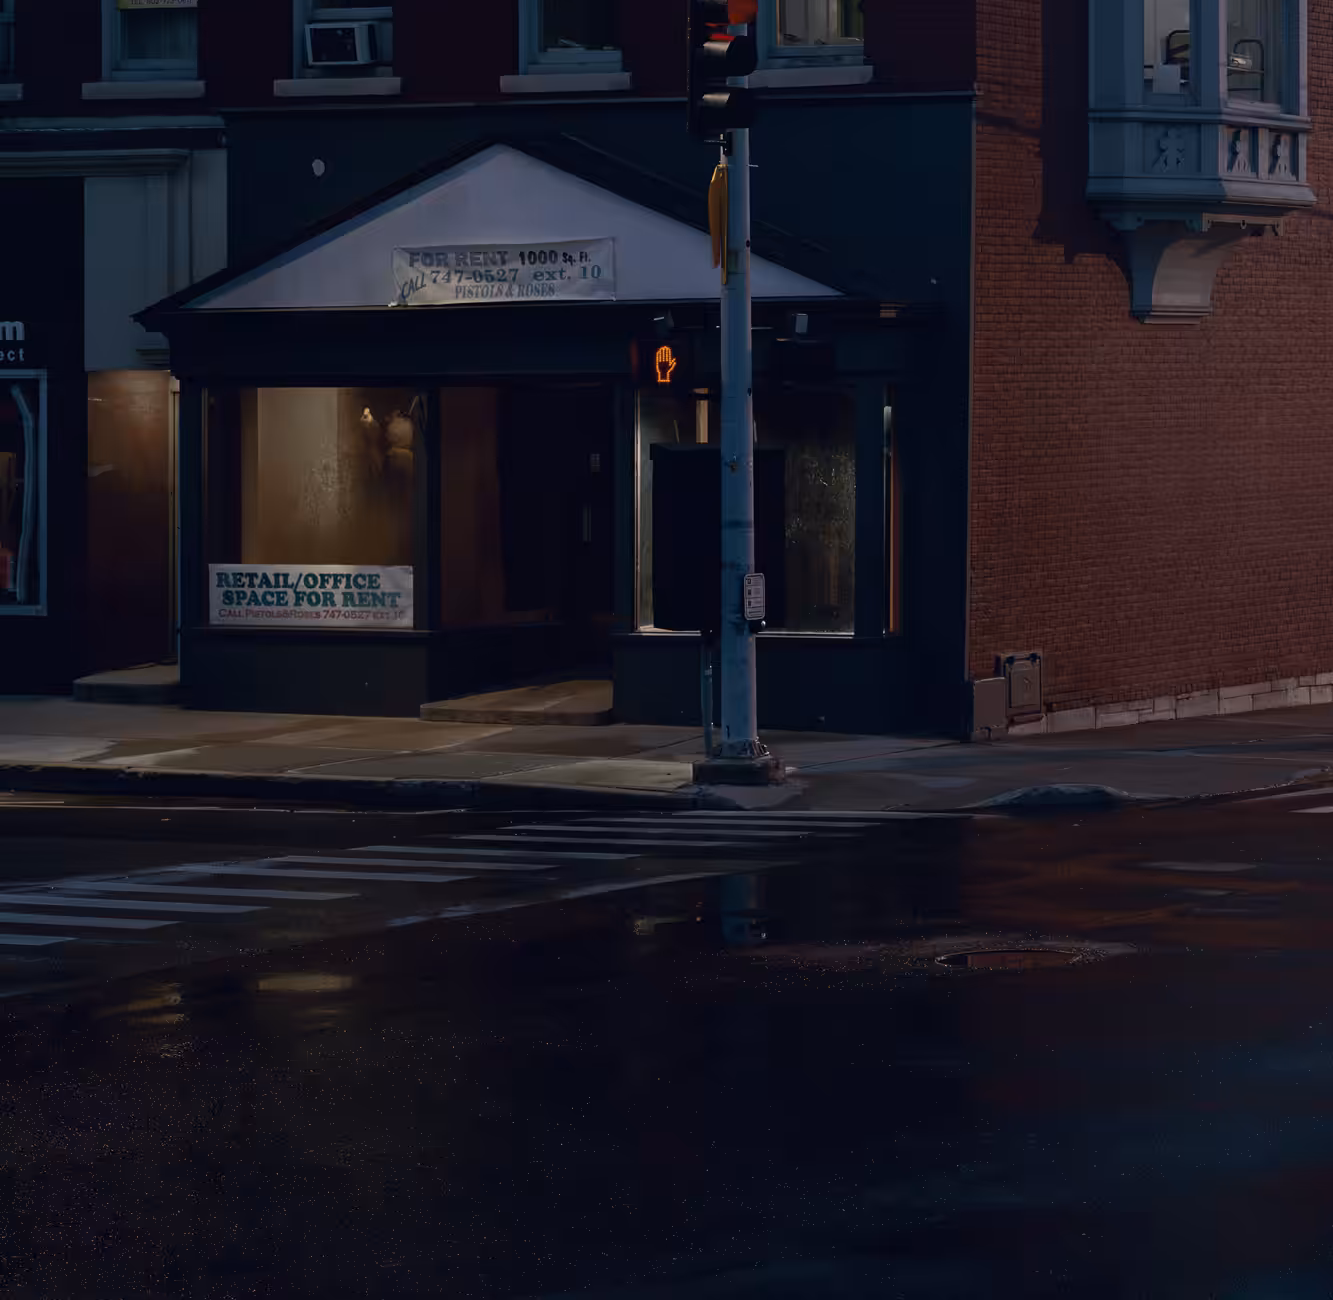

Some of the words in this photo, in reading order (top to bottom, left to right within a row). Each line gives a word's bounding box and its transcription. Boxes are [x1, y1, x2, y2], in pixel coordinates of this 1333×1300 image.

[408, 251, 449, 268] FOR
[455, 250, 509, 267] RENT
[518, 250, 558, 266] 1000
[430, 268, 519, 284] 747-0527
[532, 268, 572, 282] ext.
[579, 265, 602, 280] 10
[401, 272, 427, 300] CALL
[455, 284, 503, 300] PISTOLS
[216, 572, 381, 591] RETAIL/OFFICE
[222, 590, 289, 607] SPACE
[293, 591, 336, 607] FOR
[342, 591, 401, 608] RENT
[218, 608, 242, 618] CALL
